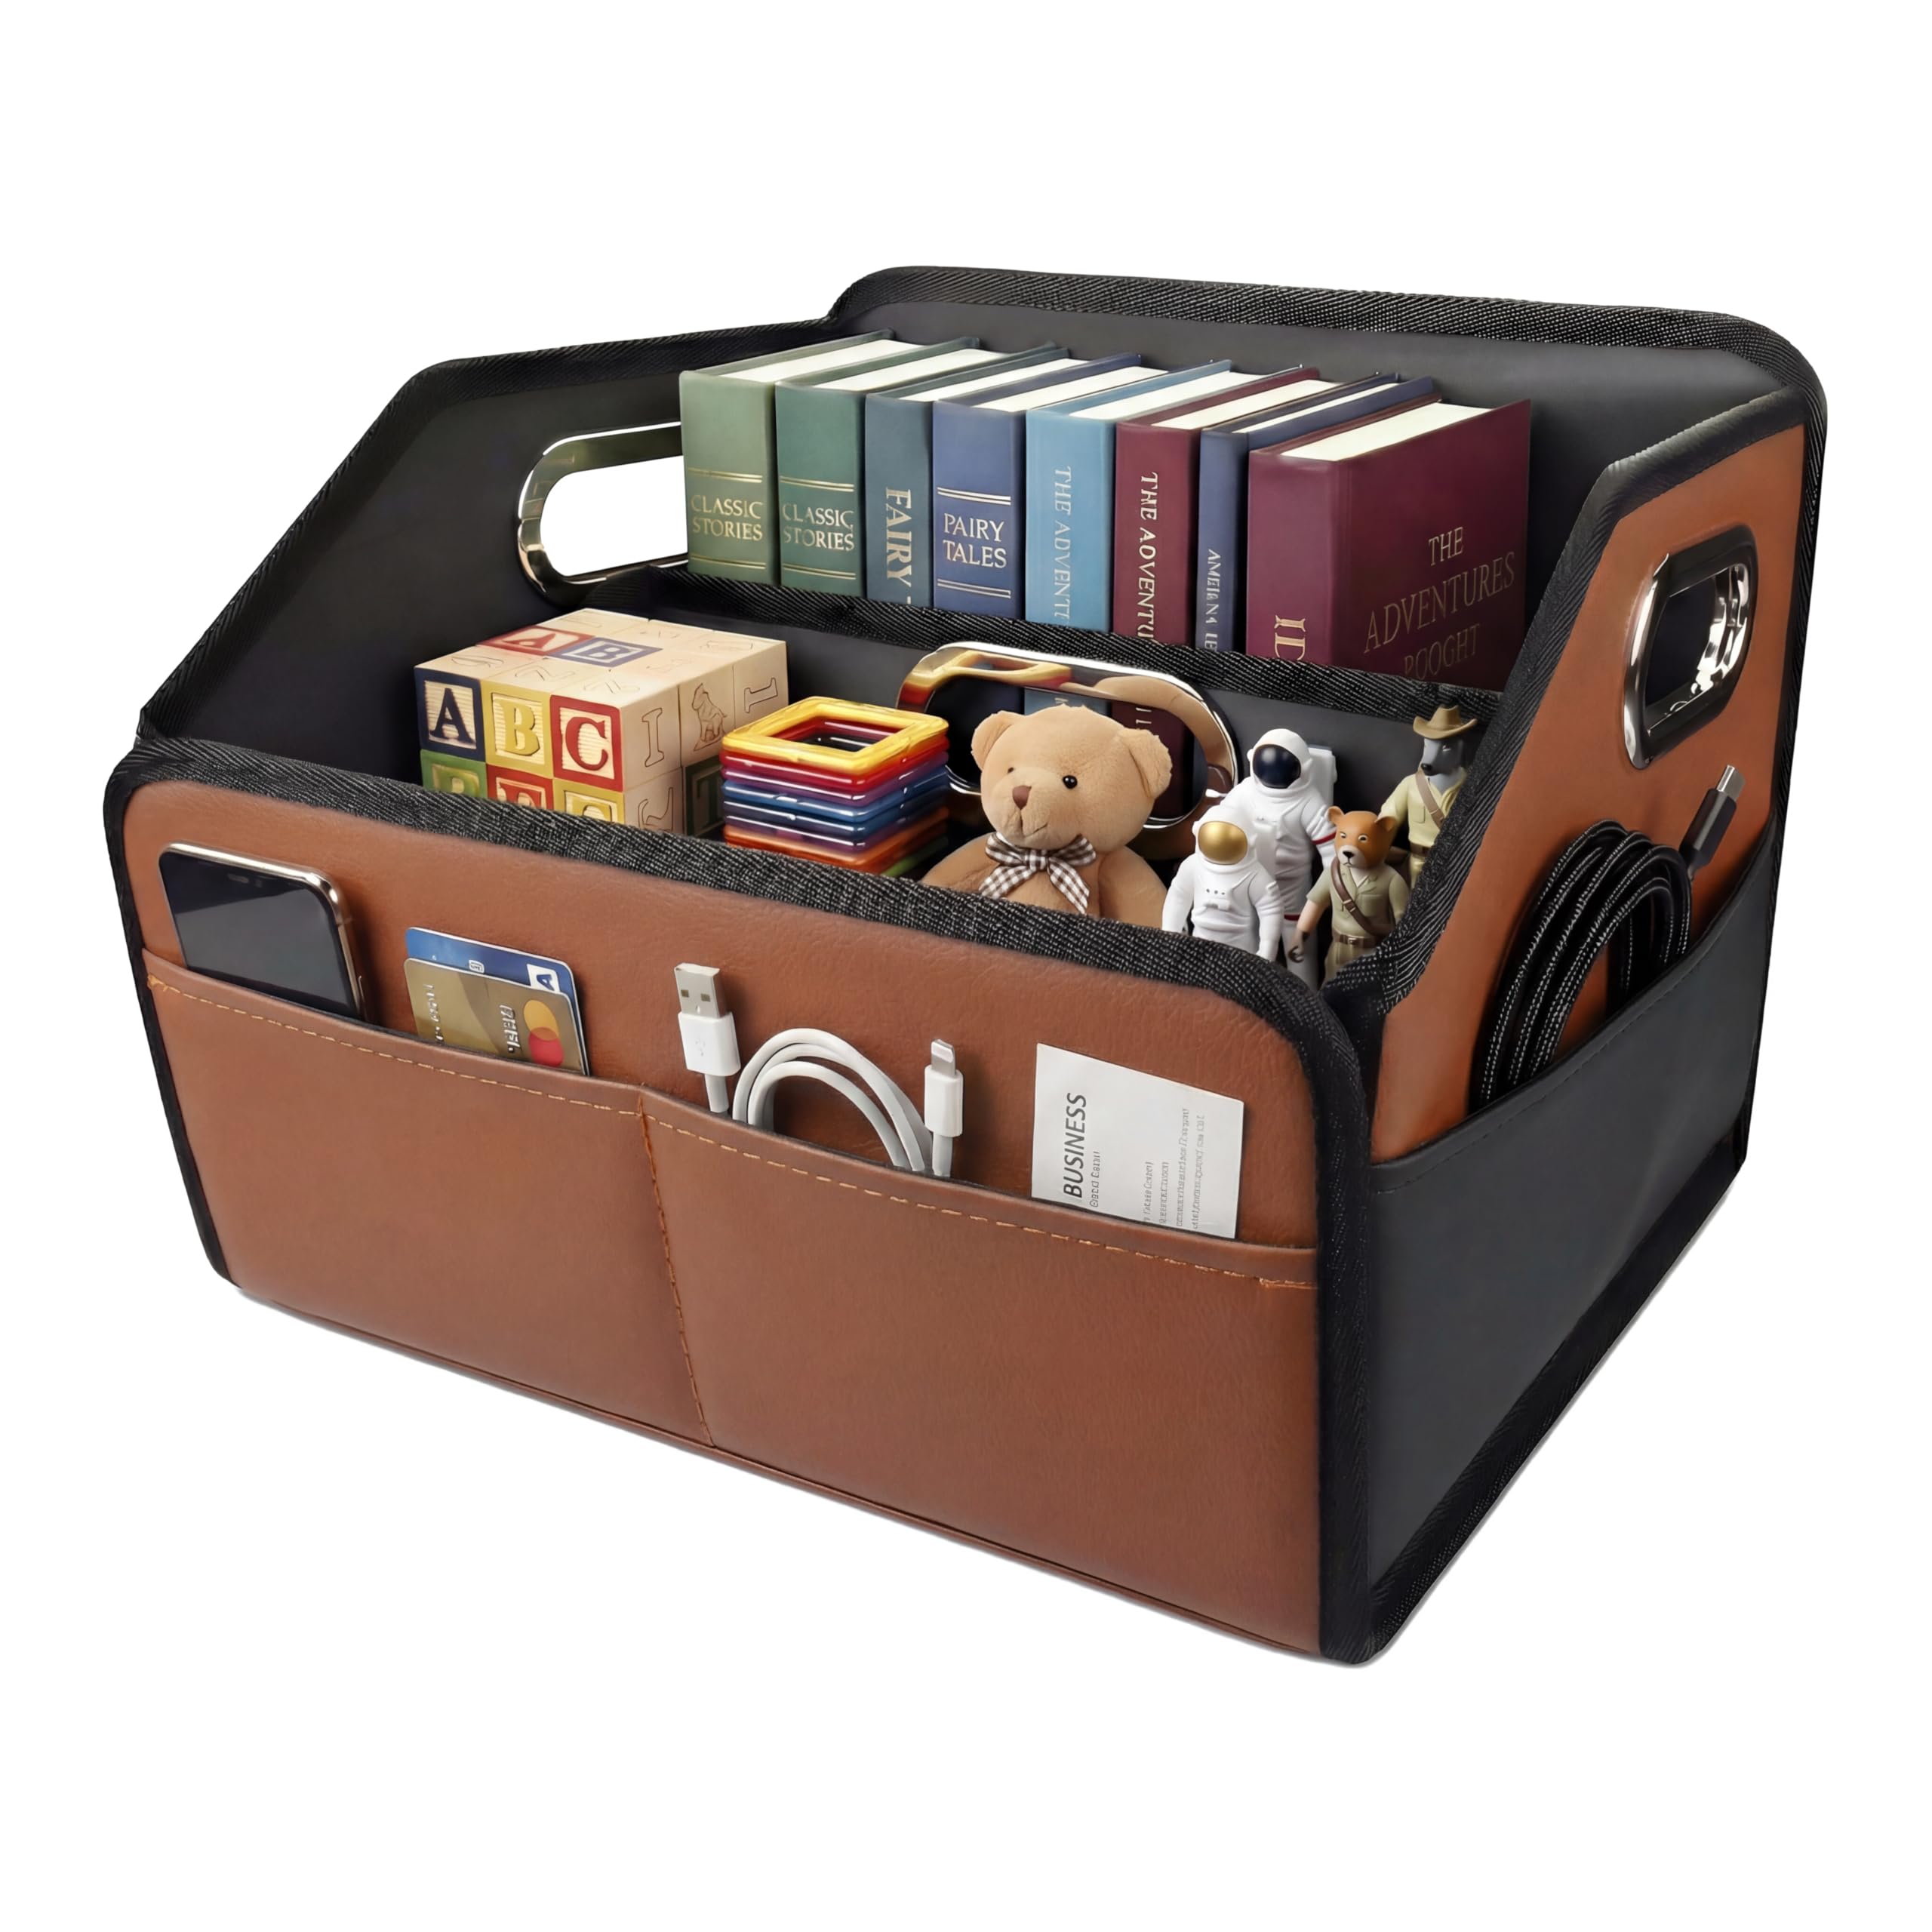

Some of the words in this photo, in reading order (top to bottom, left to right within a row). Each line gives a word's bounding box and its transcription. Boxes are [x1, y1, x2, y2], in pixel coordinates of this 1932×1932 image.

[691, 494, 764, 519] CLASSIC
[1054, 466, 1072, 515] THE
[1140, 472, 1158, 520] THE
[692, 516, 764, 542] STORIES
[782, 503, 855, 530] CLASSIC
[943, 512, 1004, 543] PAIRY
[783, 527, 855, 552] STORIES
[885, 487, 912, 588] FAIRY
[943, 539, 1008, 569] TALES
[1429, 526, 1464, 566] THE
[1364, 551, 1515, 654] ADVENTURES
[428, 687, 475, 743] A
[497, 698, 541, 757] B
[564, 715, 610, 772] C
[1063, 1092, 1088, 1198] BUSINESS
